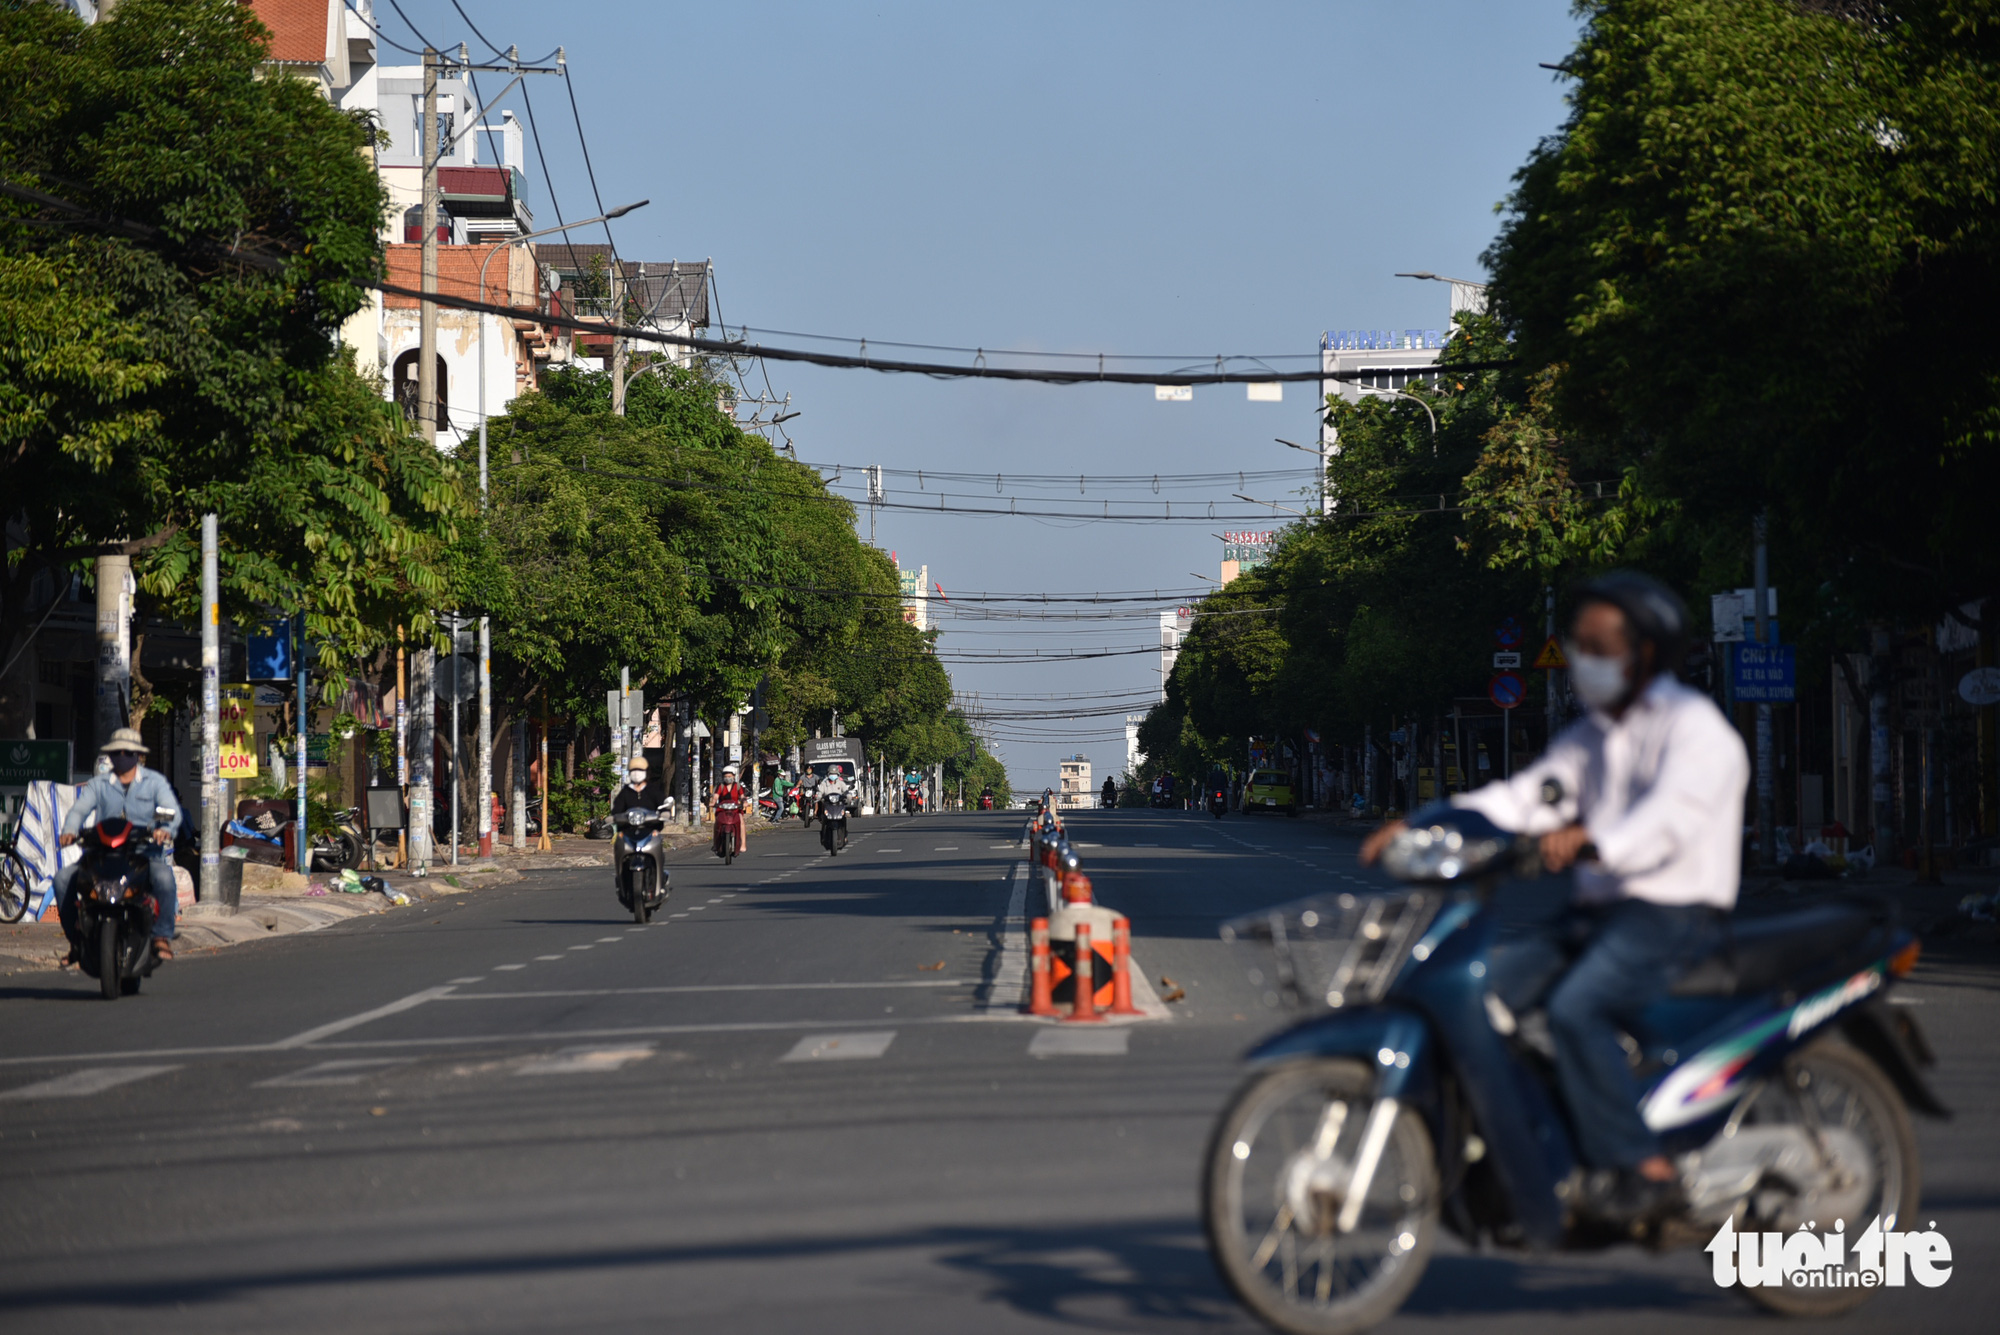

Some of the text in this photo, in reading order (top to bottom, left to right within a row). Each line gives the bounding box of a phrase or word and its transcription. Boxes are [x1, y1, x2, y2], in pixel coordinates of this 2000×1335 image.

[1327, 329, 1397, 350] MINH
[901, 570, 915, 579] BIA
[1741, 644, 1766, 663] CHÚ
[1742, 665, 1784, 680] XE RA VÀO
[1769, 684, 1795, 699] XUYÊN
[219, 704, 247, 724] HỘT
[222, 731, 246, 748] VỊT
[220, 752, 250, 772] LỘN
